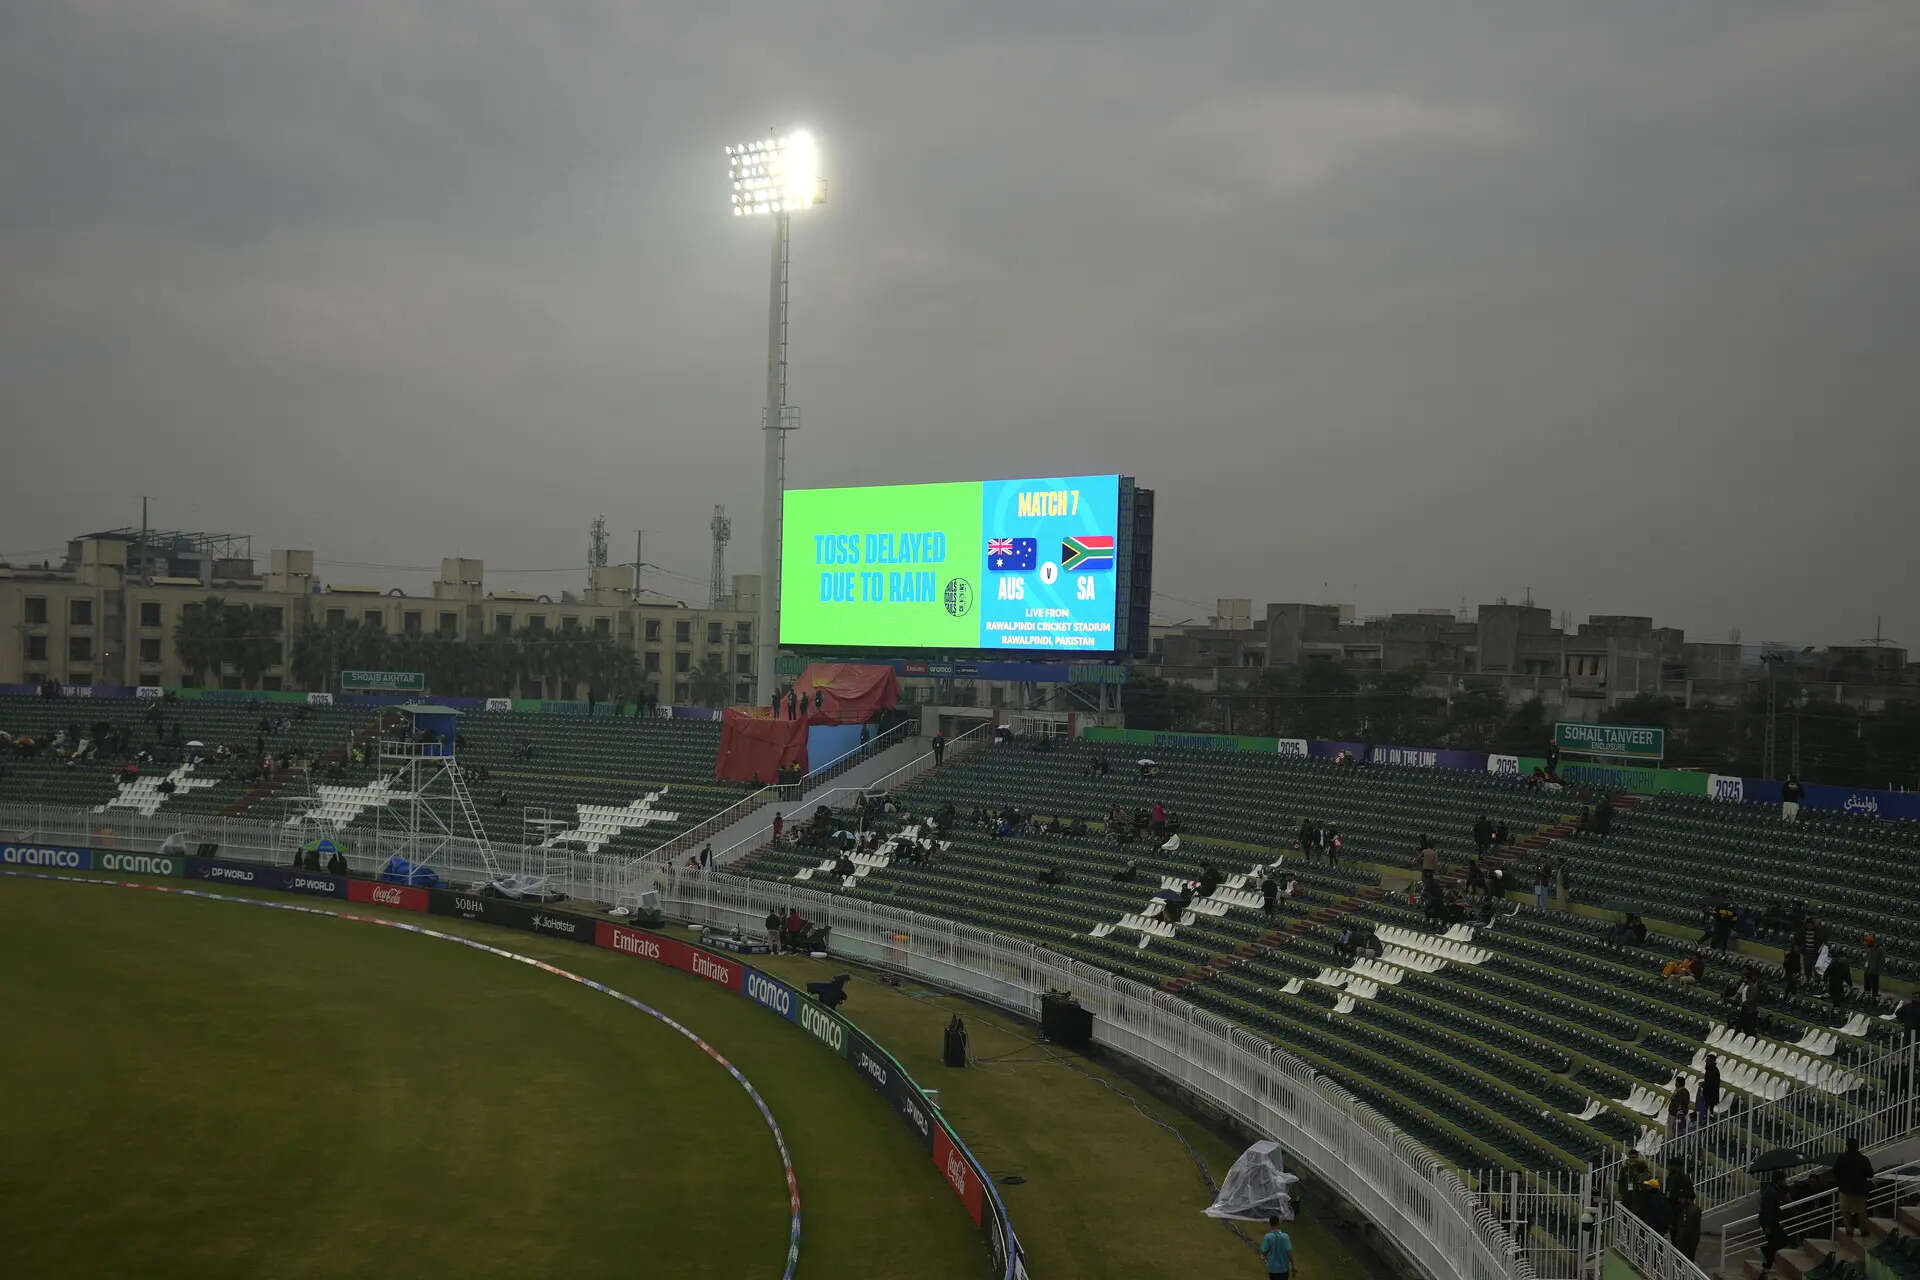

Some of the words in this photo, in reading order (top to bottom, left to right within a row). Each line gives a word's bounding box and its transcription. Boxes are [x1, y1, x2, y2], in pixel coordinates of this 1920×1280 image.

[1018, 490, 1068, 517] MATCH
[1072, 490, 1079, 515] 7
[814, 534, 860, 565] TOSS
[865, 531, 946, 564] DELAYED
[1046, 567, 1052, 580] V
[820, 571, 855, 602] DUE
[860, 571, 884, 602] TO
[889, 571, 936, 602] RAIN
[998, 576, 1024, 600] AUS
[1077, 575, 1095, 600] SA
[1025, 608, 1044, 618] LIVE
[1045, 608, 1069, 618] FROM
[986, 622, 1036, 632] RAWALPINDI
[1037, 622, 1072, 632] CRICKET
[1073, 622, 1111, 633] STADIUM
[1055, 636, 1095, 647] PAKISTAN
[1068, 664, 1126, 684] CHAMPIONS
[1564, 727, 1603, 742] SOHAIL
[1604, 729, 1654, 744] TANVEER
[1280, 742, 1300, 757] 2025
[1389, 749, 1401, 765] ON
[1402, 750, 1417, 767] THE
[1419, 752, 1437, 767] LINE
[1497, 758, 1517, 774] 2025
[1716, 779, 1741, 801] 2025
[4, 848, 79, 867] aramco
[103, 854, 172, 875] aramco
[211, 867, 223, 877] DP
[224, 869, 254, 881] WORLD
[295, 878, 305, 888] DP
[306, 880, 335, 892] WORLD
[455, 898, 484, 913] SOBHA
[613, 929, 660, 959] Emirates
[692, 953, 729, 984] Emirates
[748, 974, 789, 1014] aramco
[802, 1004, 842, 1051] aramco
[861, 1052, 869, 1067] DP
[868, 1060, 887, 1085] WORLD
